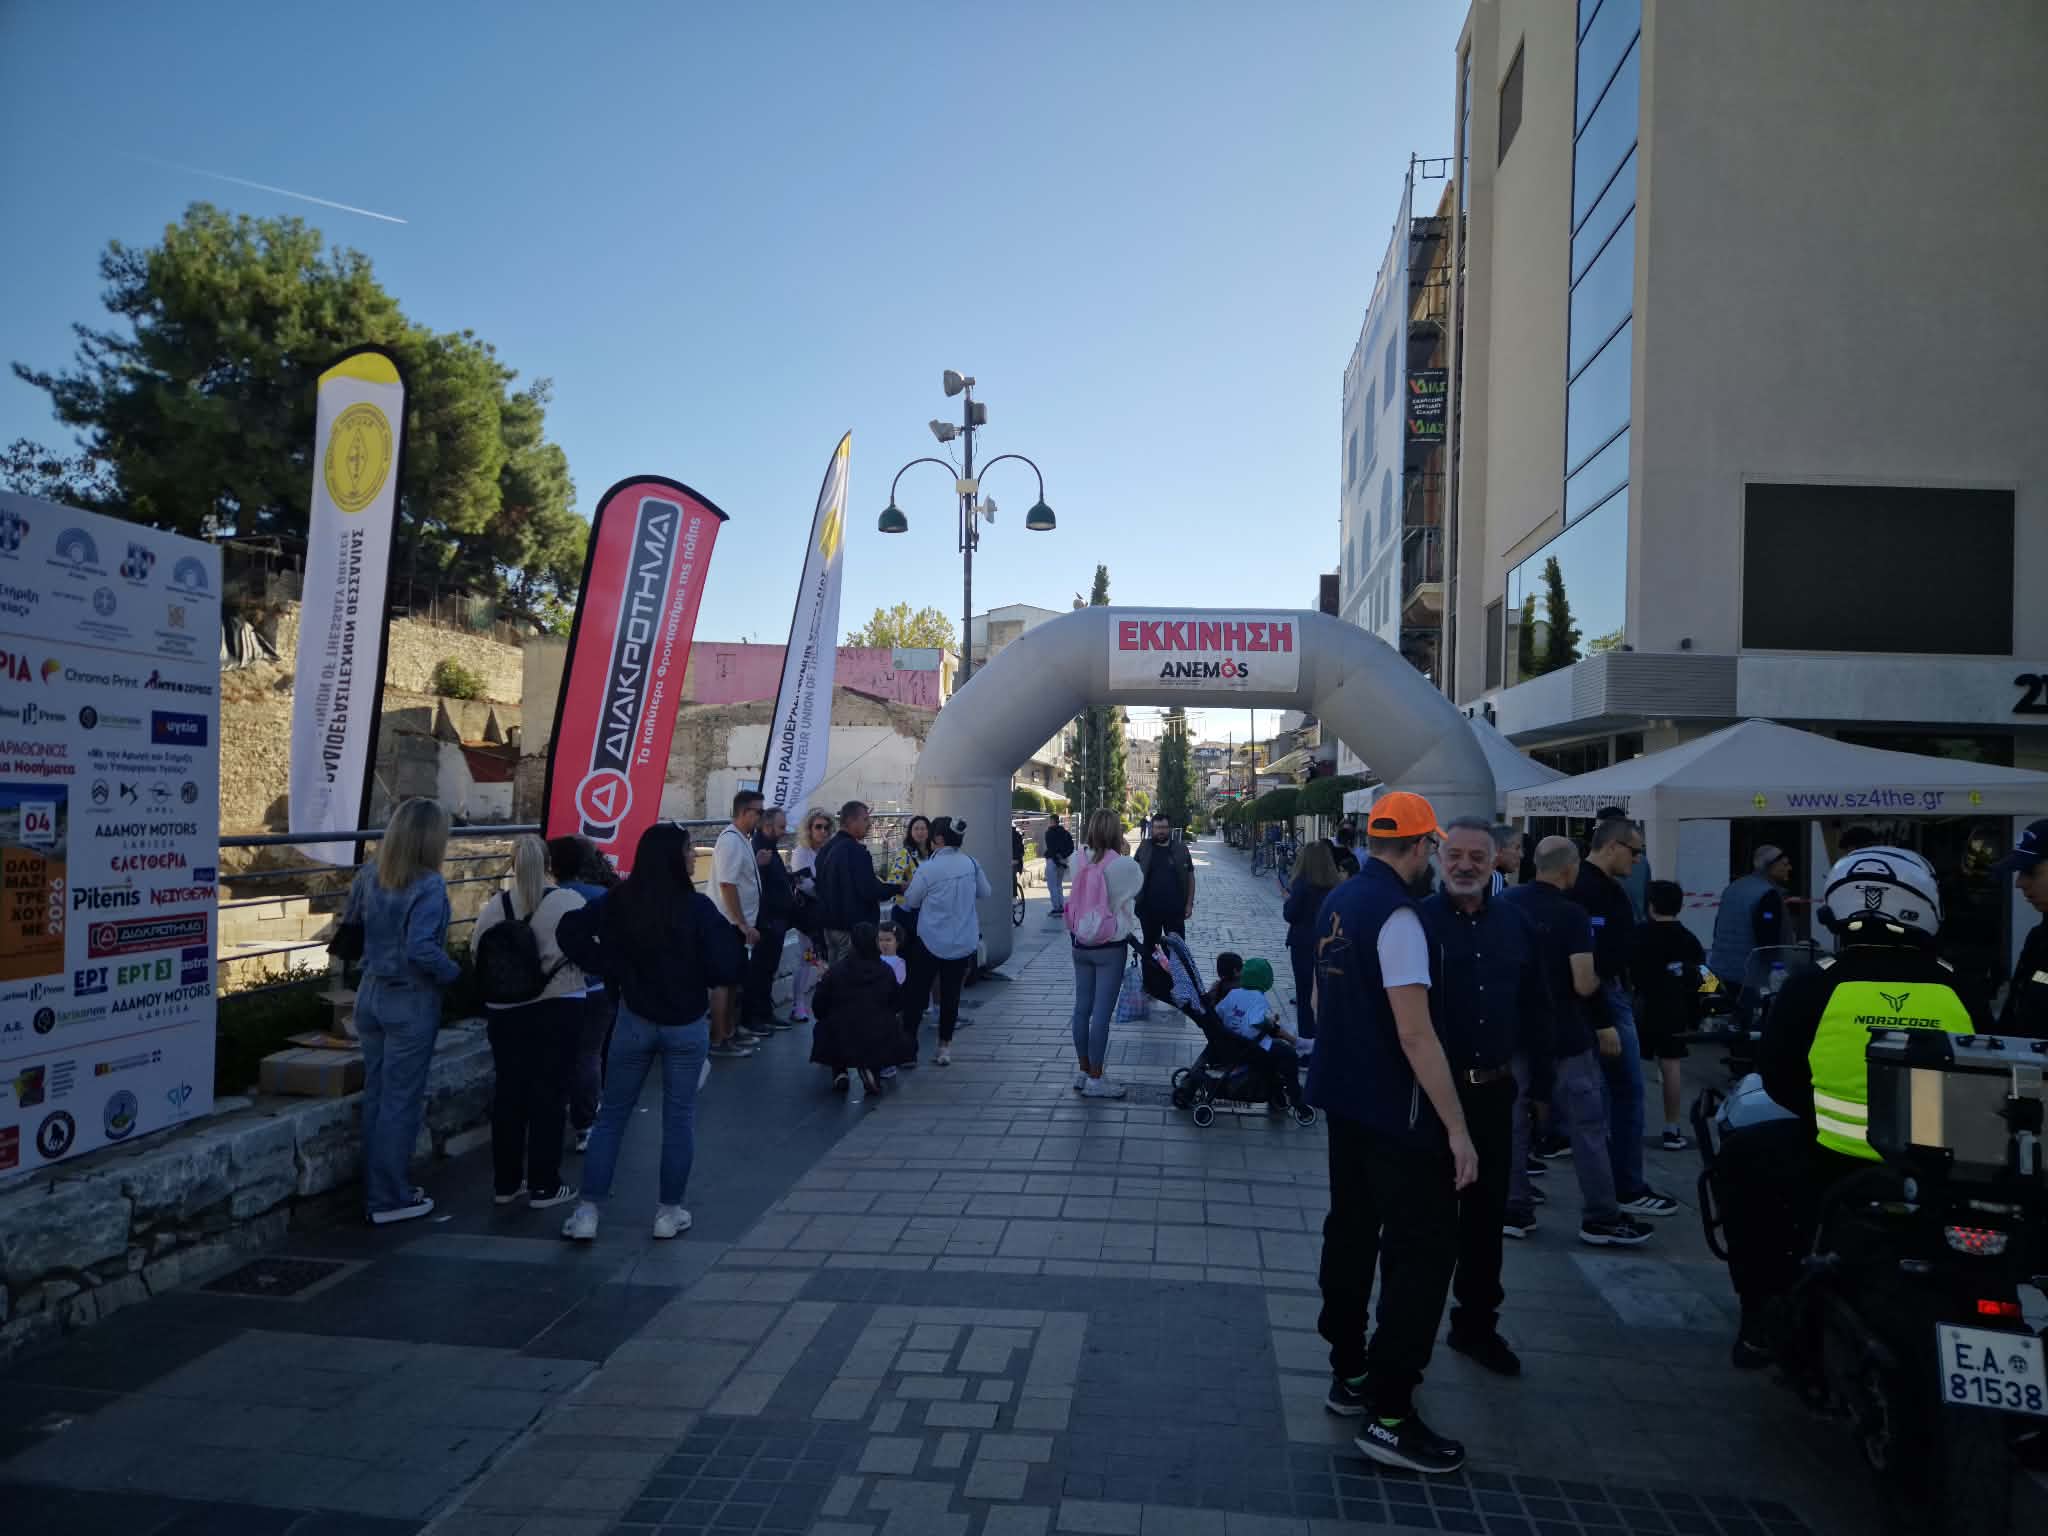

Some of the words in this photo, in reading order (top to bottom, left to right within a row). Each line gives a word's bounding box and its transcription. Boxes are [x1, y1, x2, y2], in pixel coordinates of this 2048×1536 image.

[605, 512, 673, 761] ΔΙΑΚΡΟΤΗΜΑ
[1118, 620, 1293, 653] ΕΚΚΙΝΗΣΗ
[112, 674, 139, 689] Print
[643, 681, 664, 744] καλύτερα
[1787, 788, 1945, 811] www.sz4the.gr
[25, 813, 50, 832] 04
[95, 824, 147, 838] ΑΔΑΜΟΥ
[150, 824, 197, 836] MOTORS
[111, 852, 187, 872] ΕΛΕΥΘΕΡΙΑ
[48, 877, 65, 936] 2026
[72, 886, 141, 911] Pitenis
[74, 967, 109, 988] ΕΡΤ
[117, 964, 152, 986] ΕΡΤ
[111, 992, 162, 1014] ΑΔΑΜΟΥ
[164, 983, 211, 1004] MOTORS
[1854, 1014, 1942, 1028] NORDCODE
[1950, 1373, 2042, 1410] 81538
[1367, 1423, 1399, 1447] HOKA
